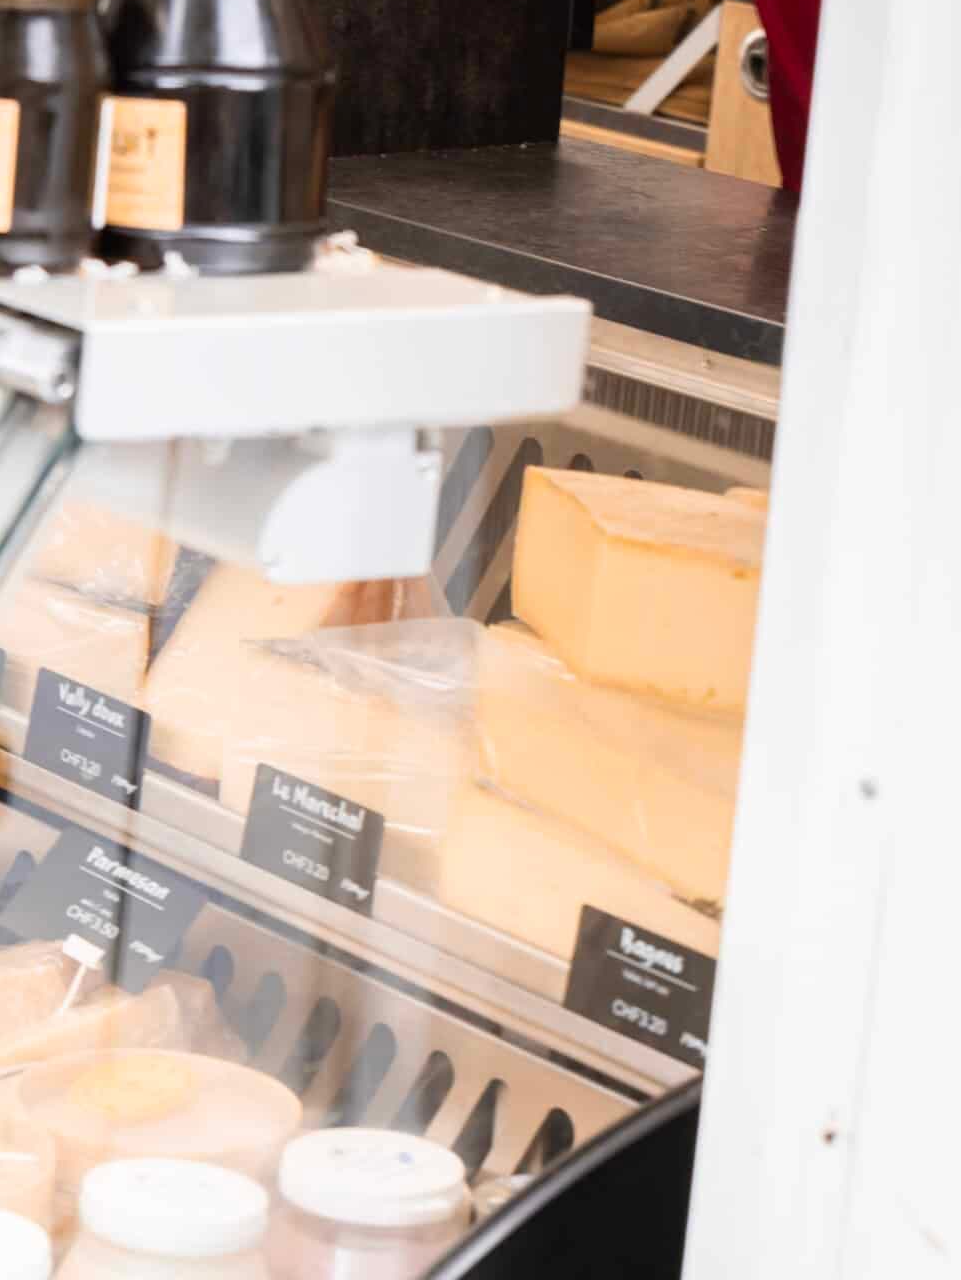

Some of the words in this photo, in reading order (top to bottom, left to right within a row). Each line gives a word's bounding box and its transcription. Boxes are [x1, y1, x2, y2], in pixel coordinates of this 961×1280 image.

[91, 697, 126, 728] doux
[271, 774, 290, 801] Le
[86, 845, 171, 900] Parmesan
[66, 904, 119, 939] CHF3.50
